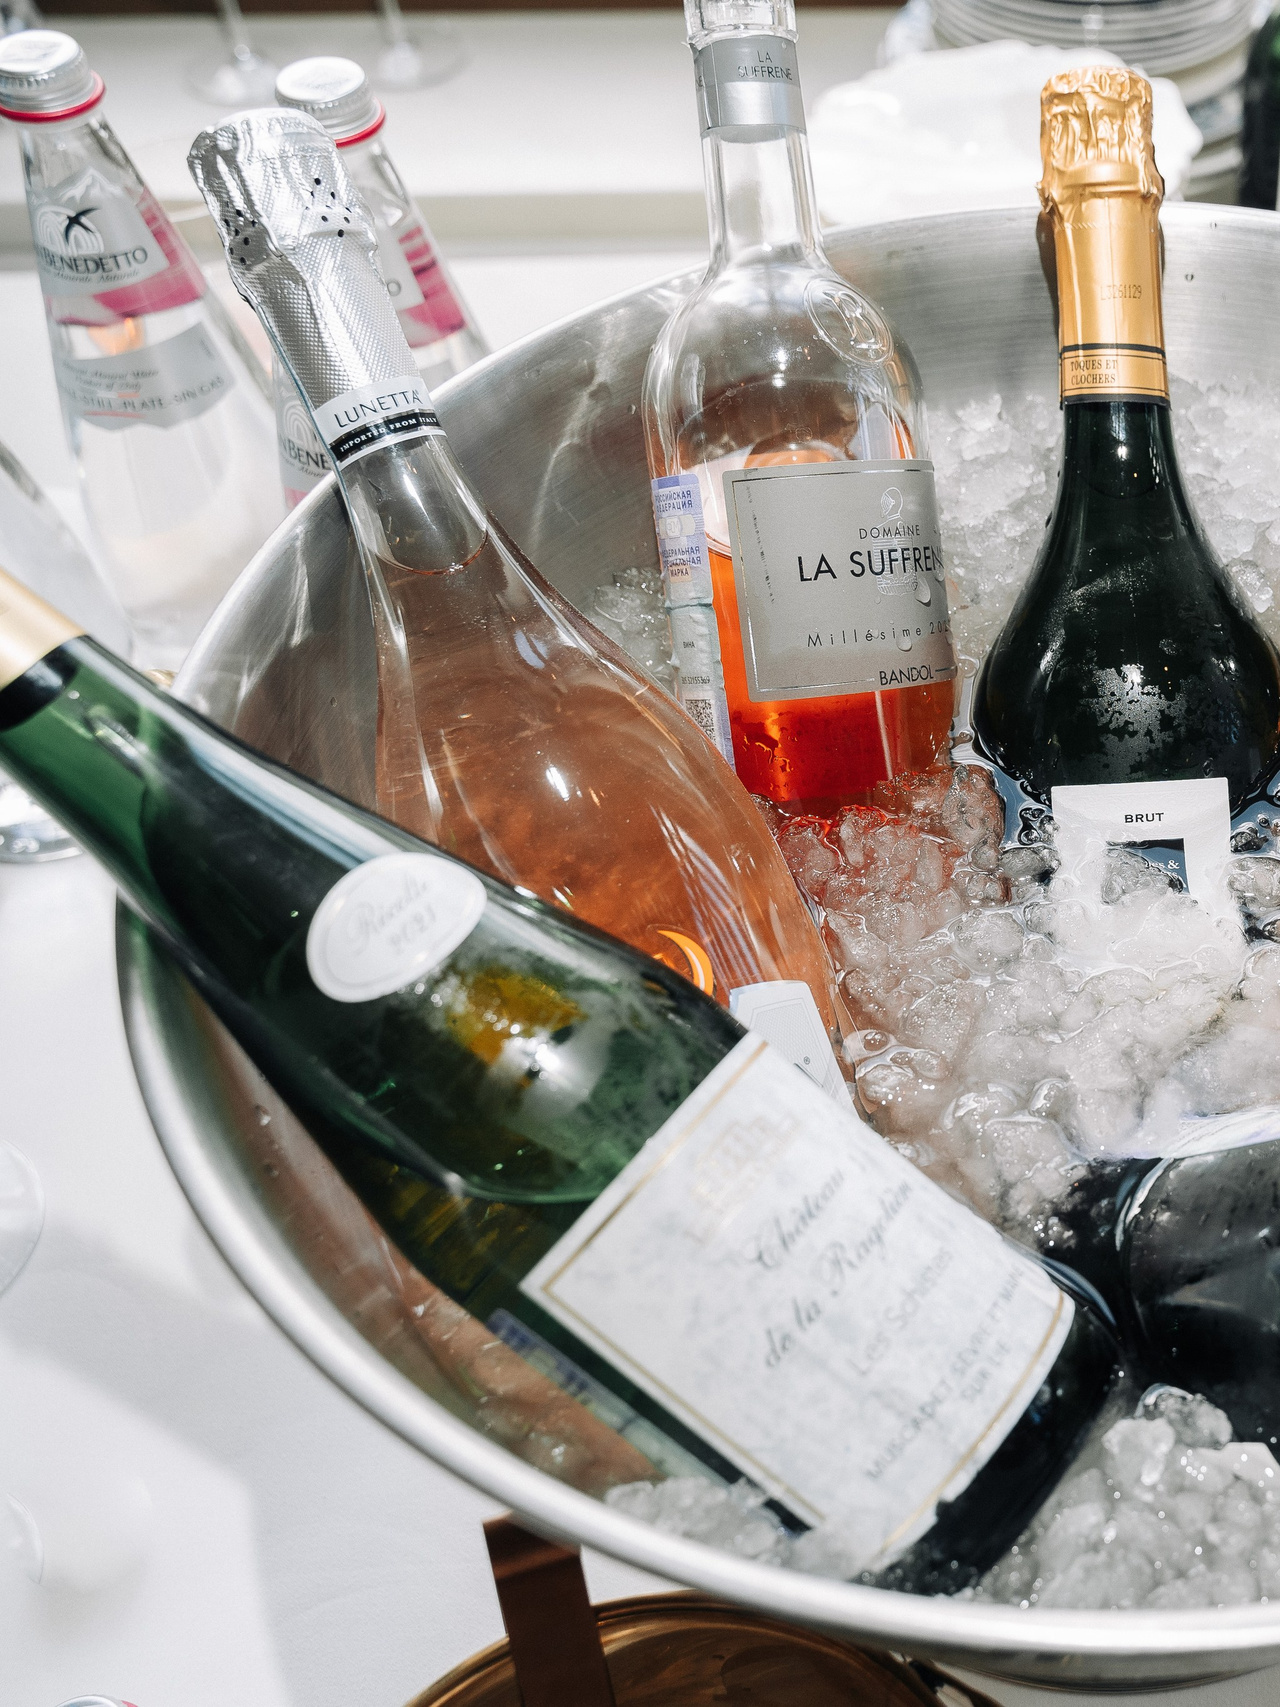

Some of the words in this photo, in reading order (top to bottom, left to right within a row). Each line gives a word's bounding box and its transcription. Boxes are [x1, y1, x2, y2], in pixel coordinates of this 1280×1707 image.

[757, 51, 773, 63] LA
[738, 66, 793, 81] SUFFRENE
[1070, 359, 1102, 372] TOQUES
[1105, 359, 1117, 370] ET
[1070, 373, 1116, 386] CLOCHERS
[334, 389, 424, 428] LUNETTA
[340, 427, 387, 453] IMPORTED
[389, 418, 418, 430] FROM
[859, 524, 921, 540] DOMAINE
[797, 552, 838, 582] LA
[849, 545, 945, 578] SUFFREN
[807, 627, 922, 648] Millésime
[929, 619, 951, 635] 202
[879, 663, 934, 686] BANDOL
[1124, 812, 1165, 823] BRUT
